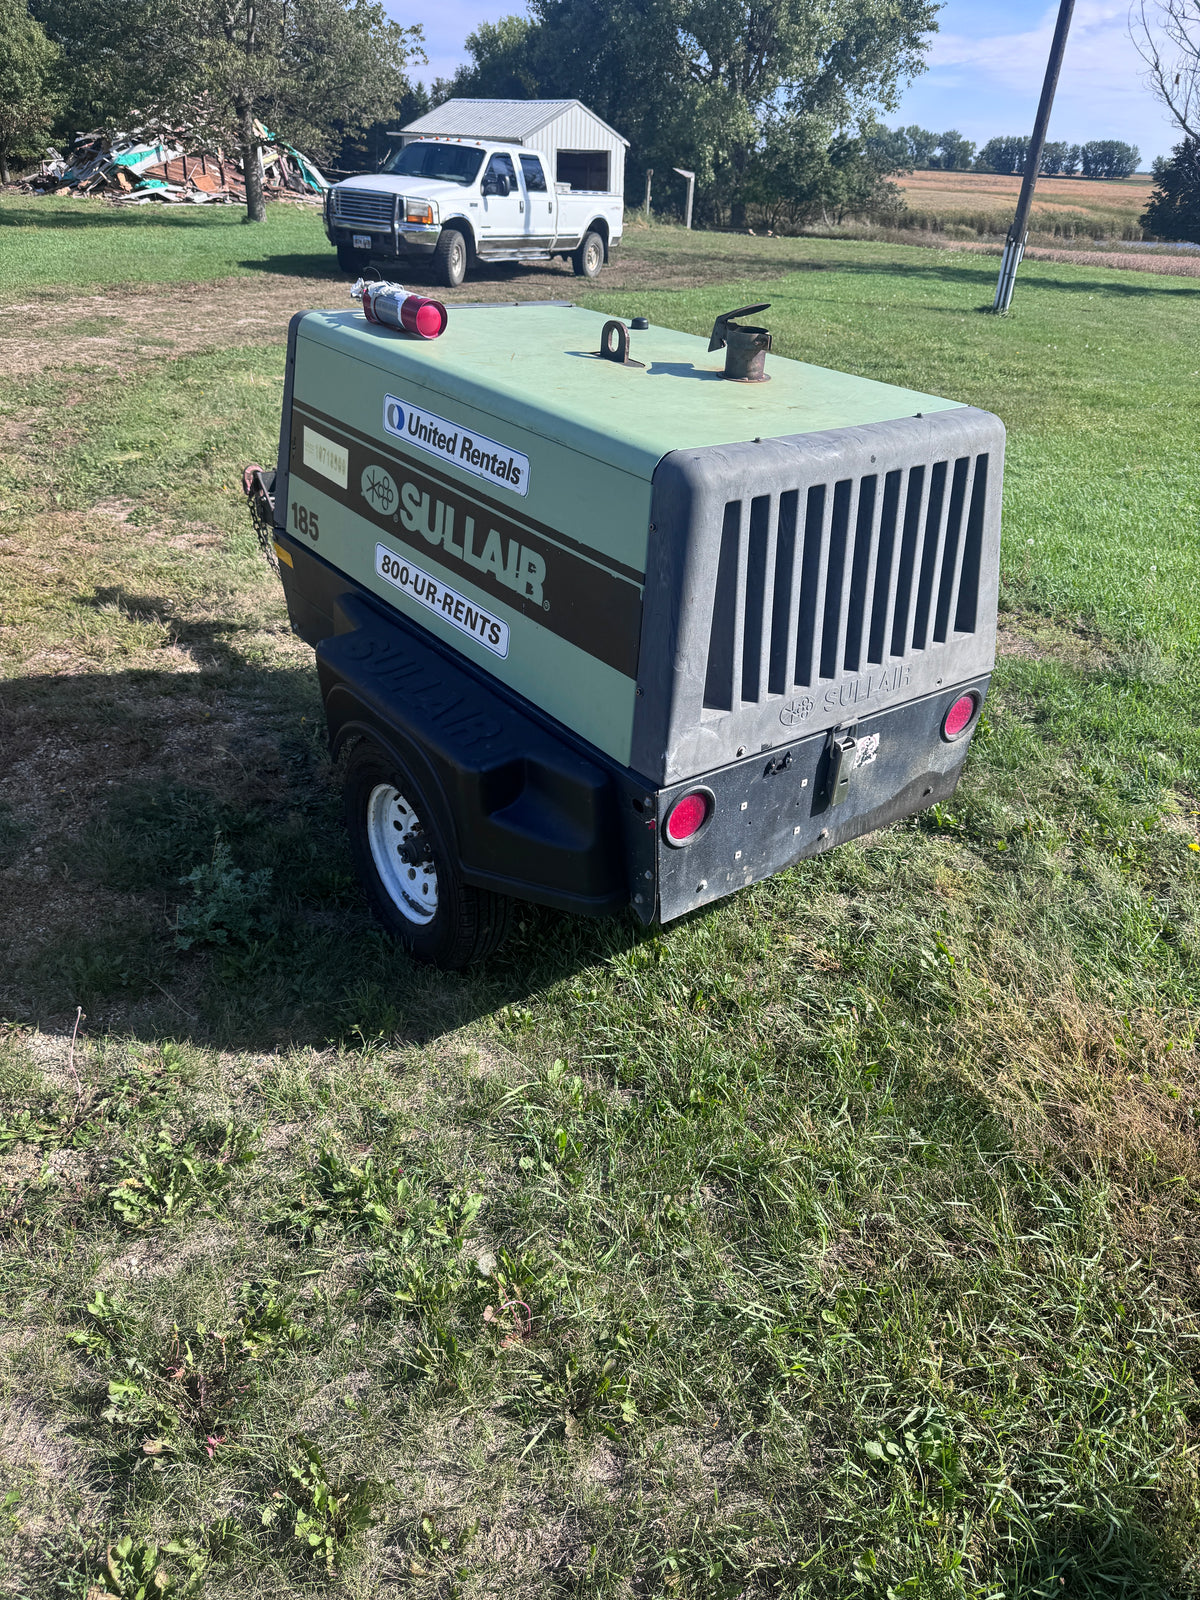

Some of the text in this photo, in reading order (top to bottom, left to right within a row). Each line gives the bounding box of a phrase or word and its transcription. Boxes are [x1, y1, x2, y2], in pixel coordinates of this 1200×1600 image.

[407, 412, 521, 486] United Rentals
[291, 501, 320, 542] 185
[400, 481, 547, 608] SULLAIR
[381, 553, 502, 646] 800-UR-RENTS
[342, 635, 504, 748] SULLAIR
[823, 664, 913, 713] SULLAIR
